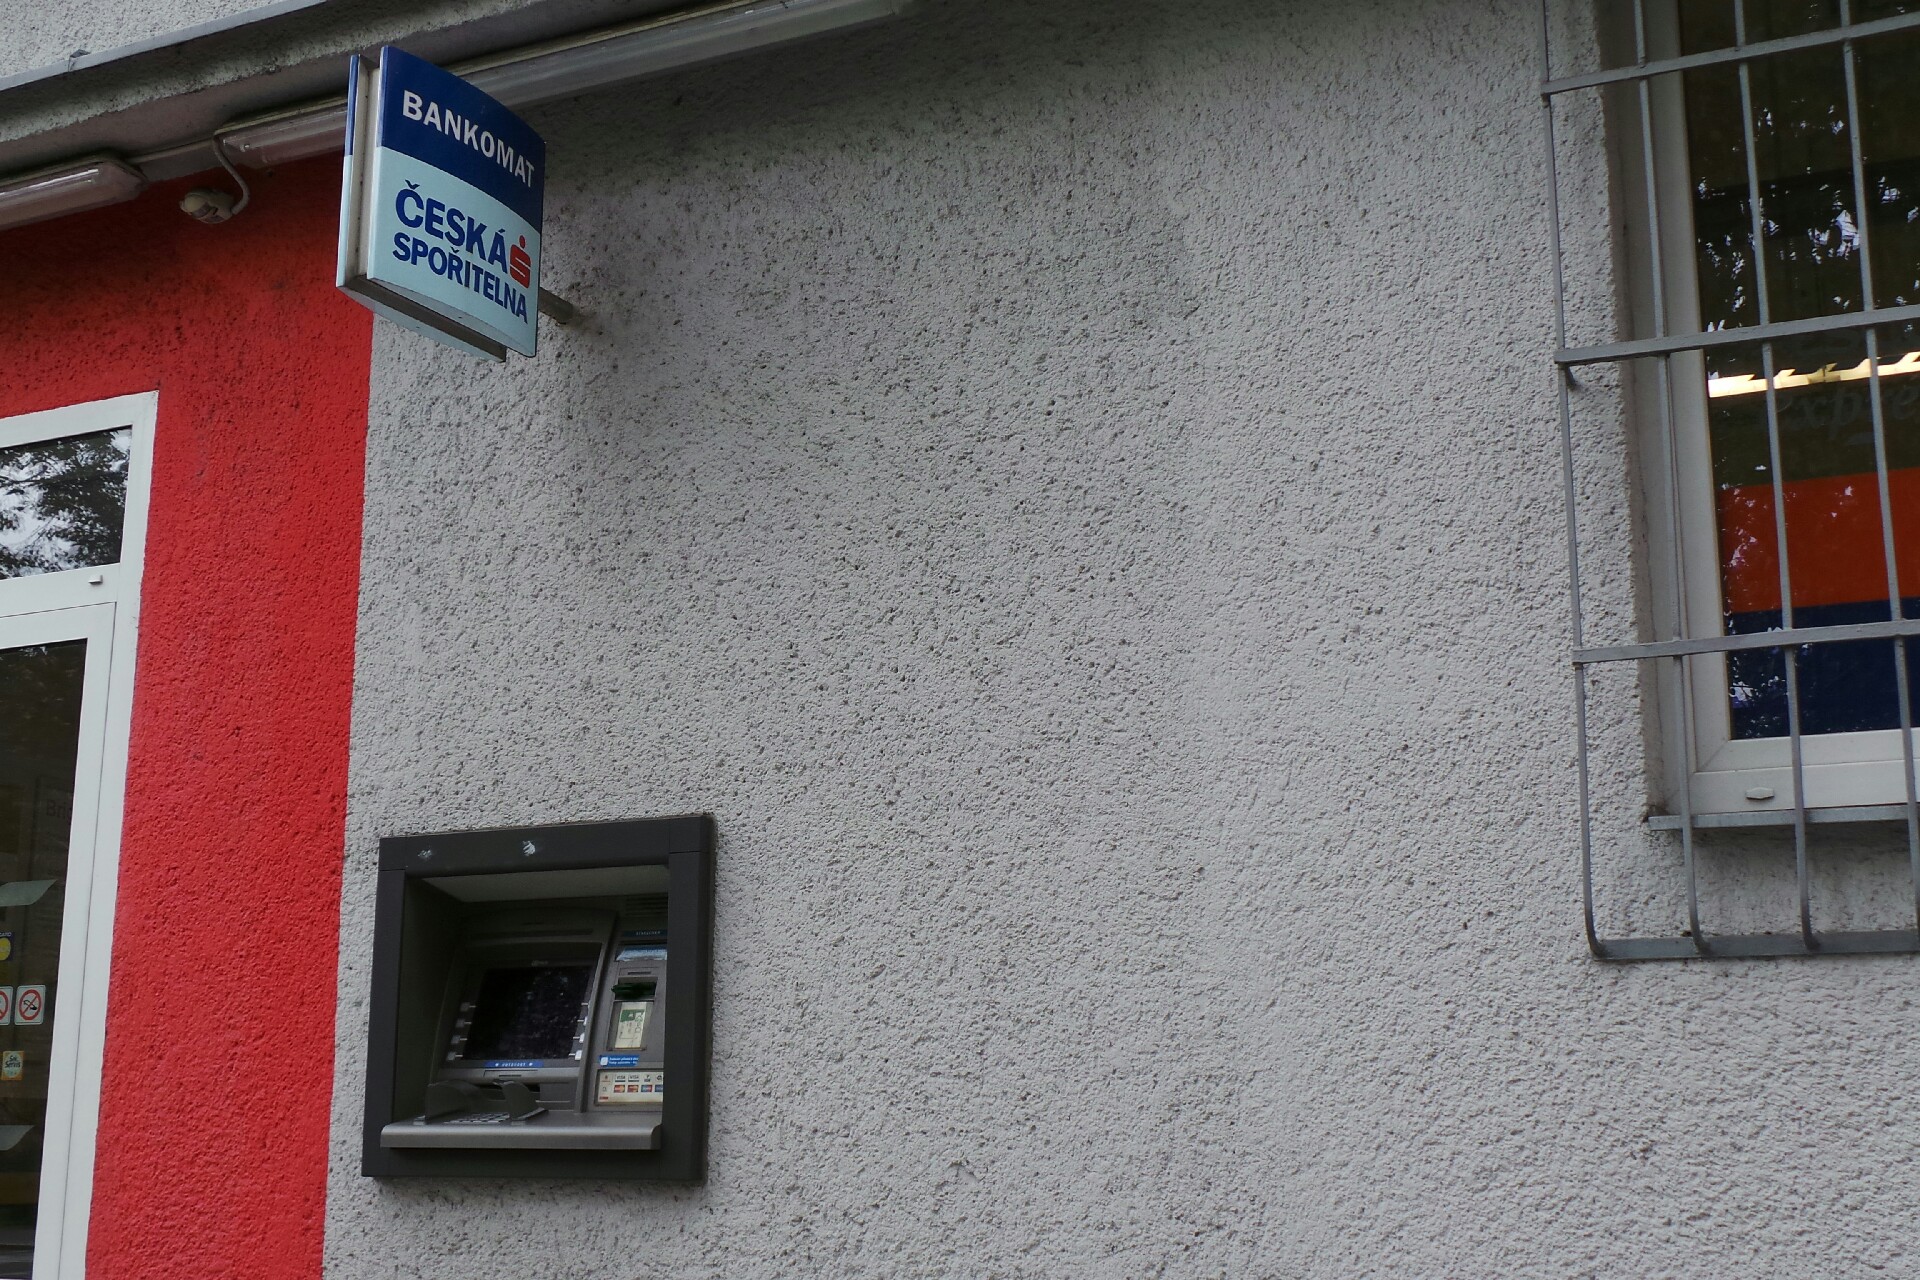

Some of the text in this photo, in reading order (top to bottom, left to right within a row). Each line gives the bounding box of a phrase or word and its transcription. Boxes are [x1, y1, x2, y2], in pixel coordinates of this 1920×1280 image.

[402, 90, 535, 188] BANKOMAT
[395, 179, 508, 274] ČESKÁ
[392, 232, 529, 324] SPOŘITELNA
